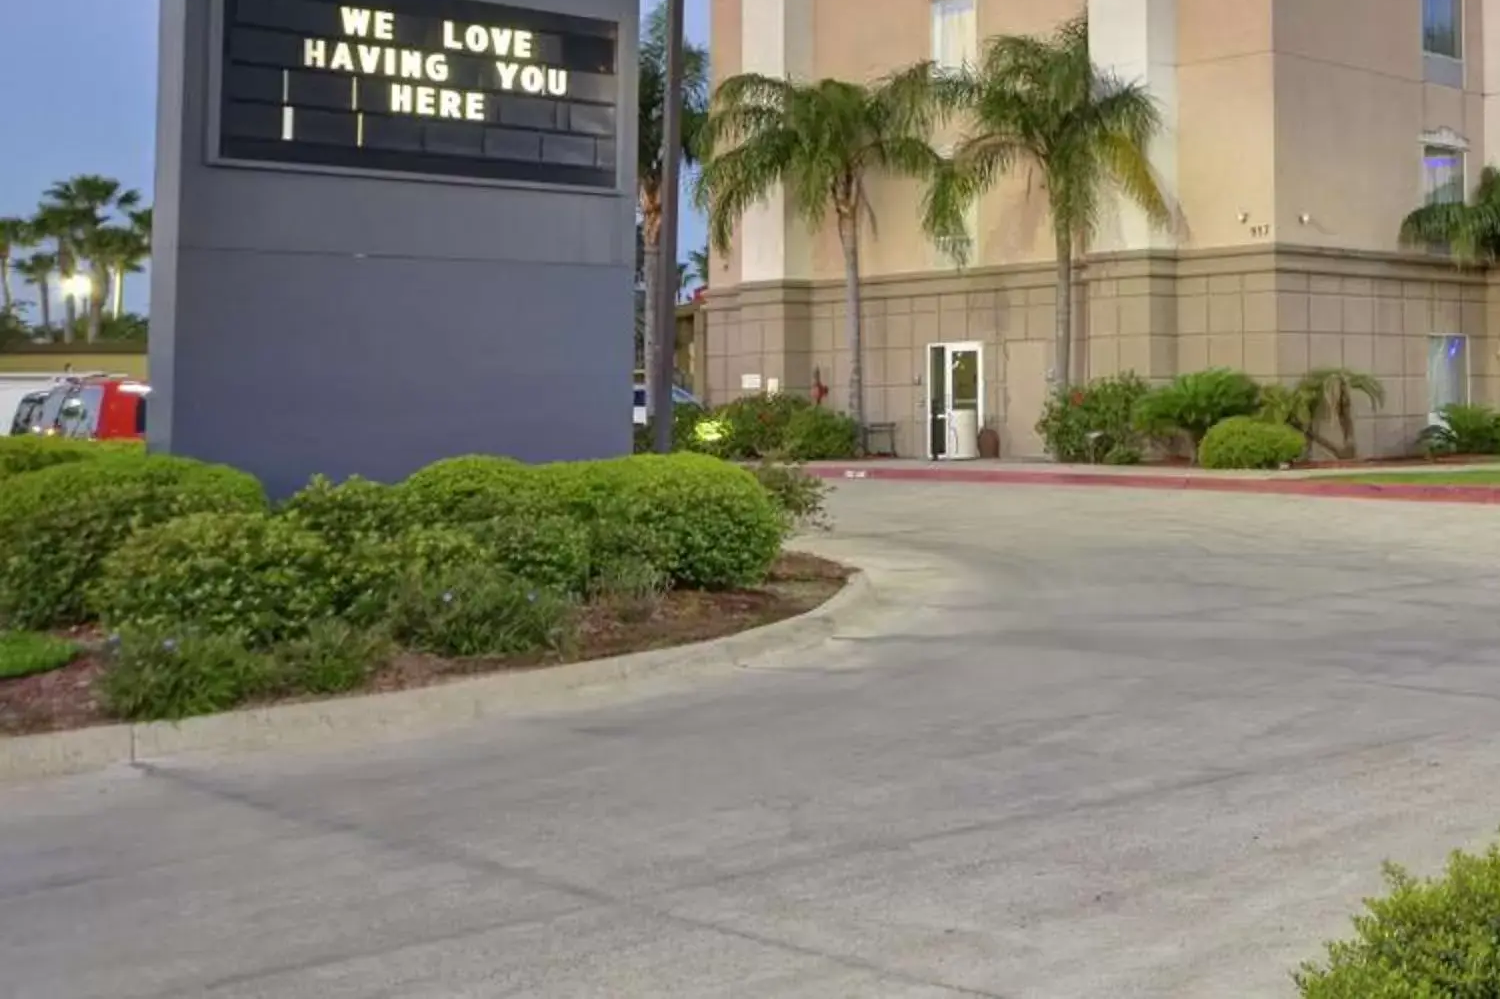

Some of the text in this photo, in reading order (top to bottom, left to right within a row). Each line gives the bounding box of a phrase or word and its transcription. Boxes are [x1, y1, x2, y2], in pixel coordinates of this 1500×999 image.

[340, 6, 533, 59] WE LOVE
[303, 38, 568, 96] HAVING YOU
[391, 84, 485, 121] HERE
